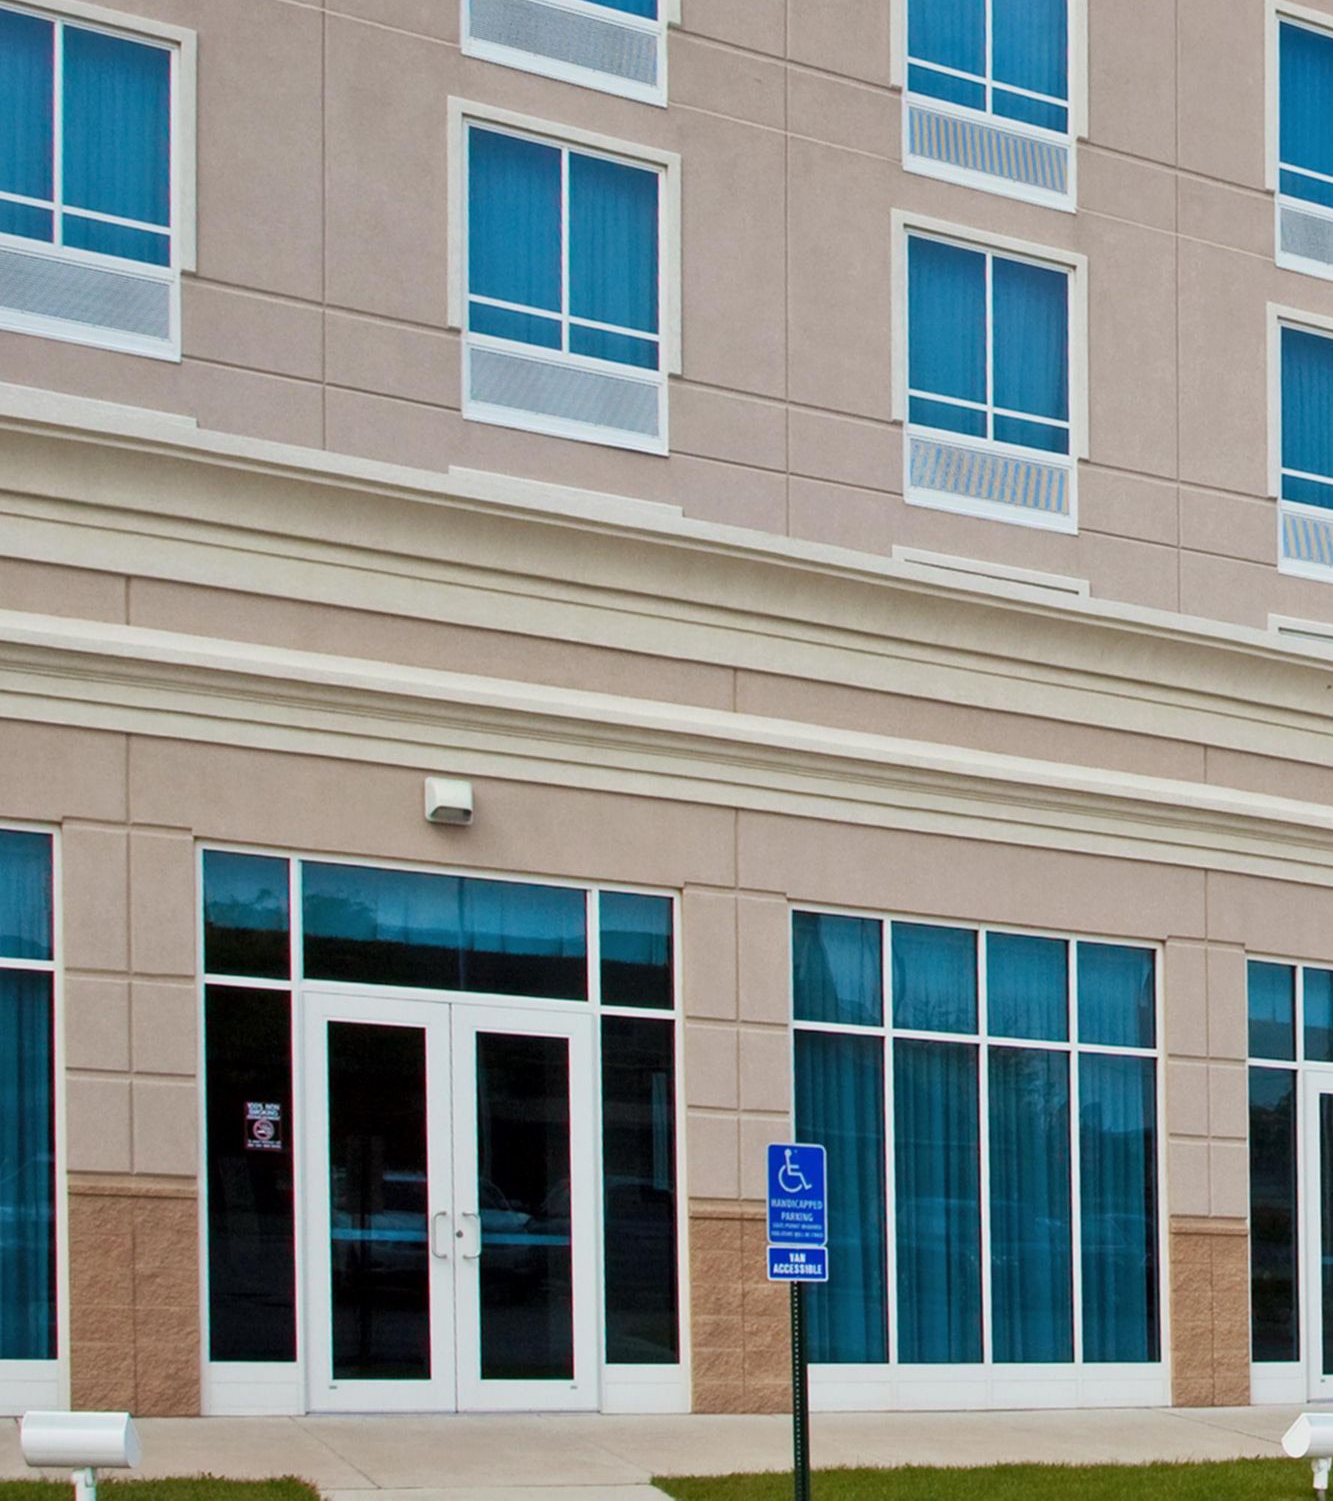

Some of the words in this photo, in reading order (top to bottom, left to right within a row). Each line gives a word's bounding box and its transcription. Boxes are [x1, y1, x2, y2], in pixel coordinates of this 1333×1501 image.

[771, 1198, 823, 1210] HANDICAPPED
[780, 1211, 814, 1222] PARKING
[789, 1253, 806, 1263] VAN
[773, 1263, 822, 1275] ACCESSIBLE
